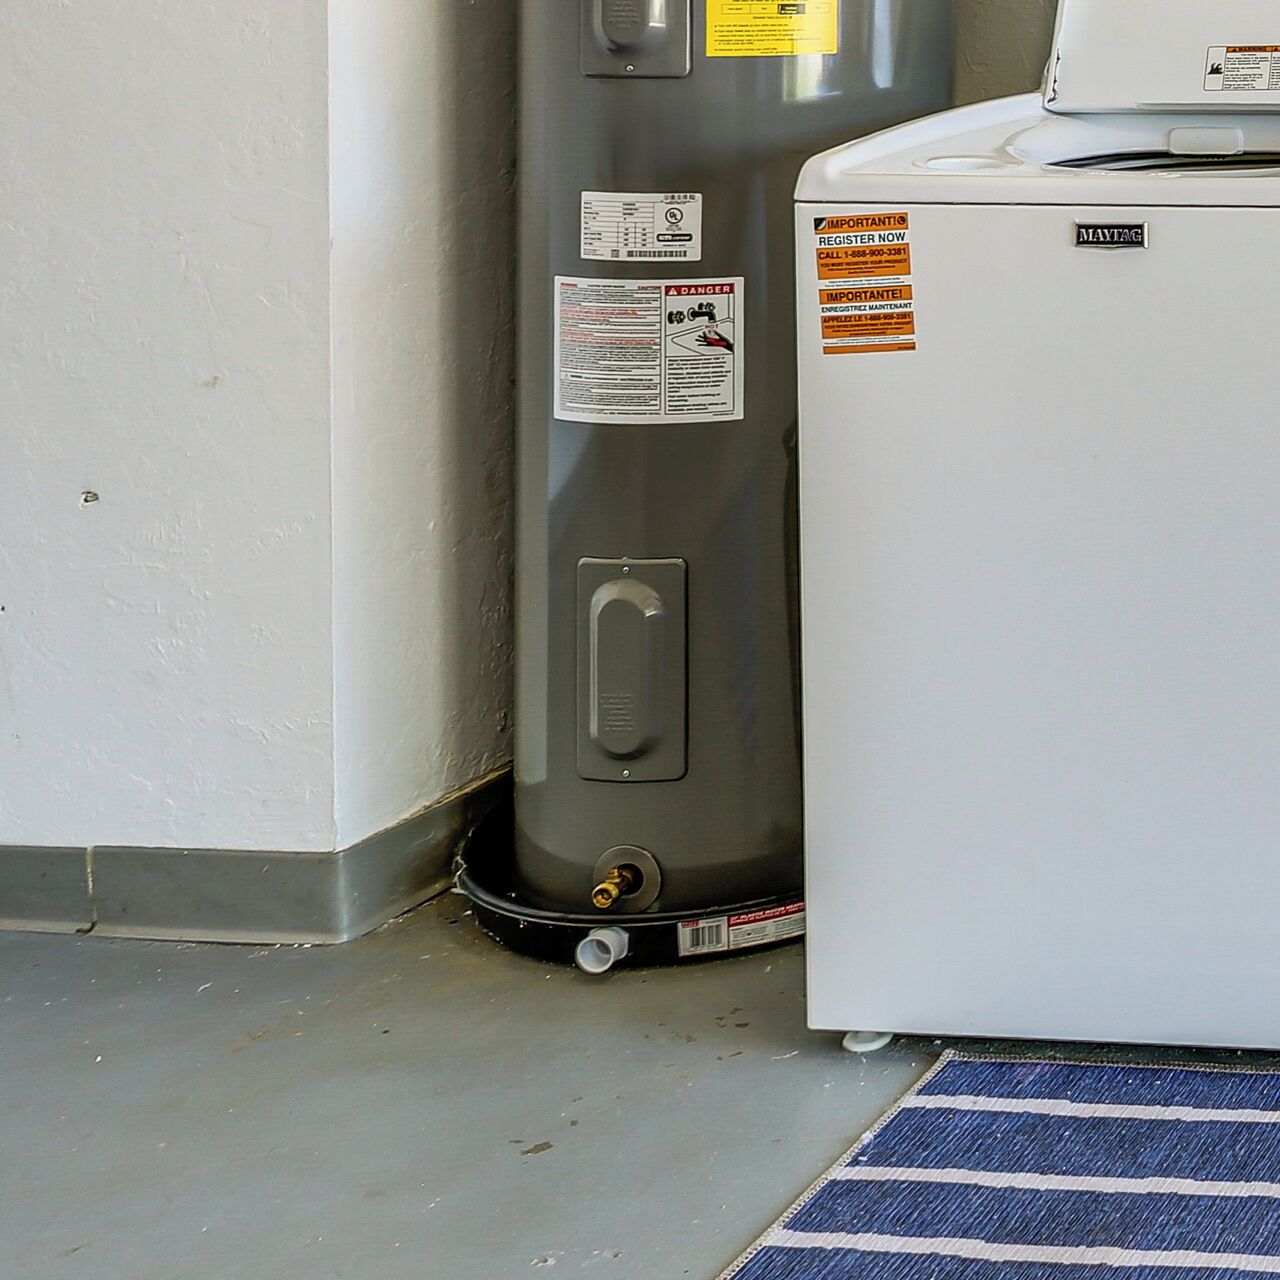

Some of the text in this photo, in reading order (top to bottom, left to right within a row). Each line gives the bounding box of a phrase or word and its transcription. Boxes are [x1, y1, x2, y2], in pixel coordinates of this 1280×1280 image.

[827, 215, 898, 230] IMPORTANT!
[818, 231, 906, 247] REGISTER NOW
[1079, 228, 1142, 242] MAYTAG
[818, 251, 843, 260] CALL
[680, 285, 730, 295] DANGER
[821, 302, 913, 313] ENREGISTREZ MAINTENANT
